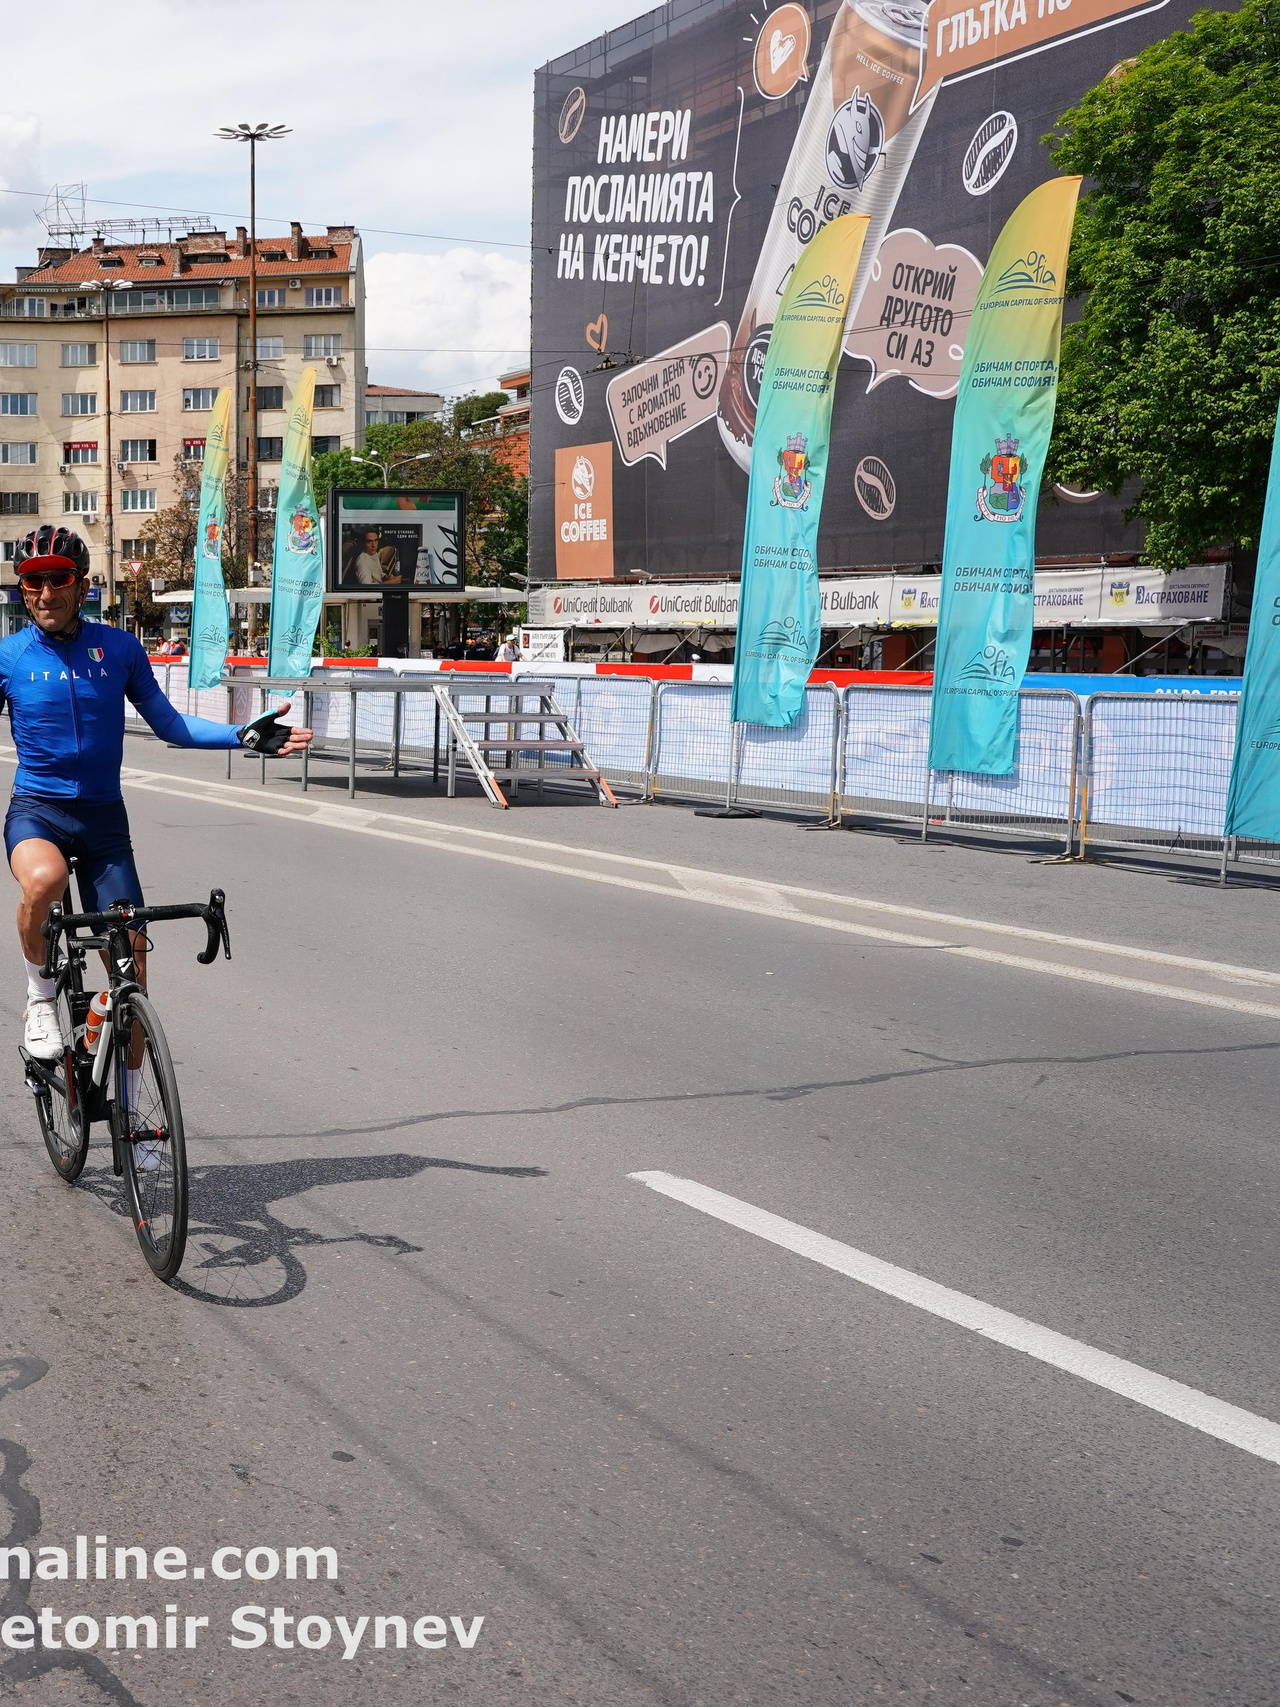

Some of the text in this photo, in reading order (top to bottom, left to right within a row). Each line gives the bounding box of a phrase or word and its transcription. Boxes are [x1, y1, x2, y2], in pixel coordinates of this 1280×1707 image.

[856, 52, 905, 85] HELL ICE COFFEE
[597, 109, 691, 164] НАМЕРИ
[565, 171, 713, 223] ПОСЛАНИЯТА
[814, 185, 851, 221] ICE
[557, 233, 709, 287] НА КЕНЧЕТО!
[892, 263, 957, 301] ОТКРИЙ
[1010, 298, 1033, 307] CAPITAL
[880, 295, 953, 337] ДРУГОТО
[886, 331, 935, 367] СИ АЗ
[621, 359, 685, 408] ЗАПОЧНИ ДЕНЯ
[772, 380, 804, 390] ОБИЧАМ
[972, 376, 1056, 388] ОБИЧАМ СОФИЯ!
[628, 383, 681, 425] С АРОМАТНО
[626, 402, 687, 448] ВДЪХНОВЕНИЕ
[574, 502, 592, 520] ICE
[561, 518, 607, 543] COFFEE
[755, 545, 789, 556] ОБИЧАМ
[753, 558, 787, 569] ОБИЧАМ
[955, 566, 1001, 578] ОБИЧАМ
[954, 582, 999, 592] ОБИЧАМ
[562, 597, 598, 613] UniCredit
[599, 597, 633, 613] Bulbank
[660, 595, 738, 613] UniCredit Bulban
[831, 591, 880, 610] Bulbank
[31, 668, 107, 682] ITALIA
[1251, 740, 1280, 751] EUROPE
